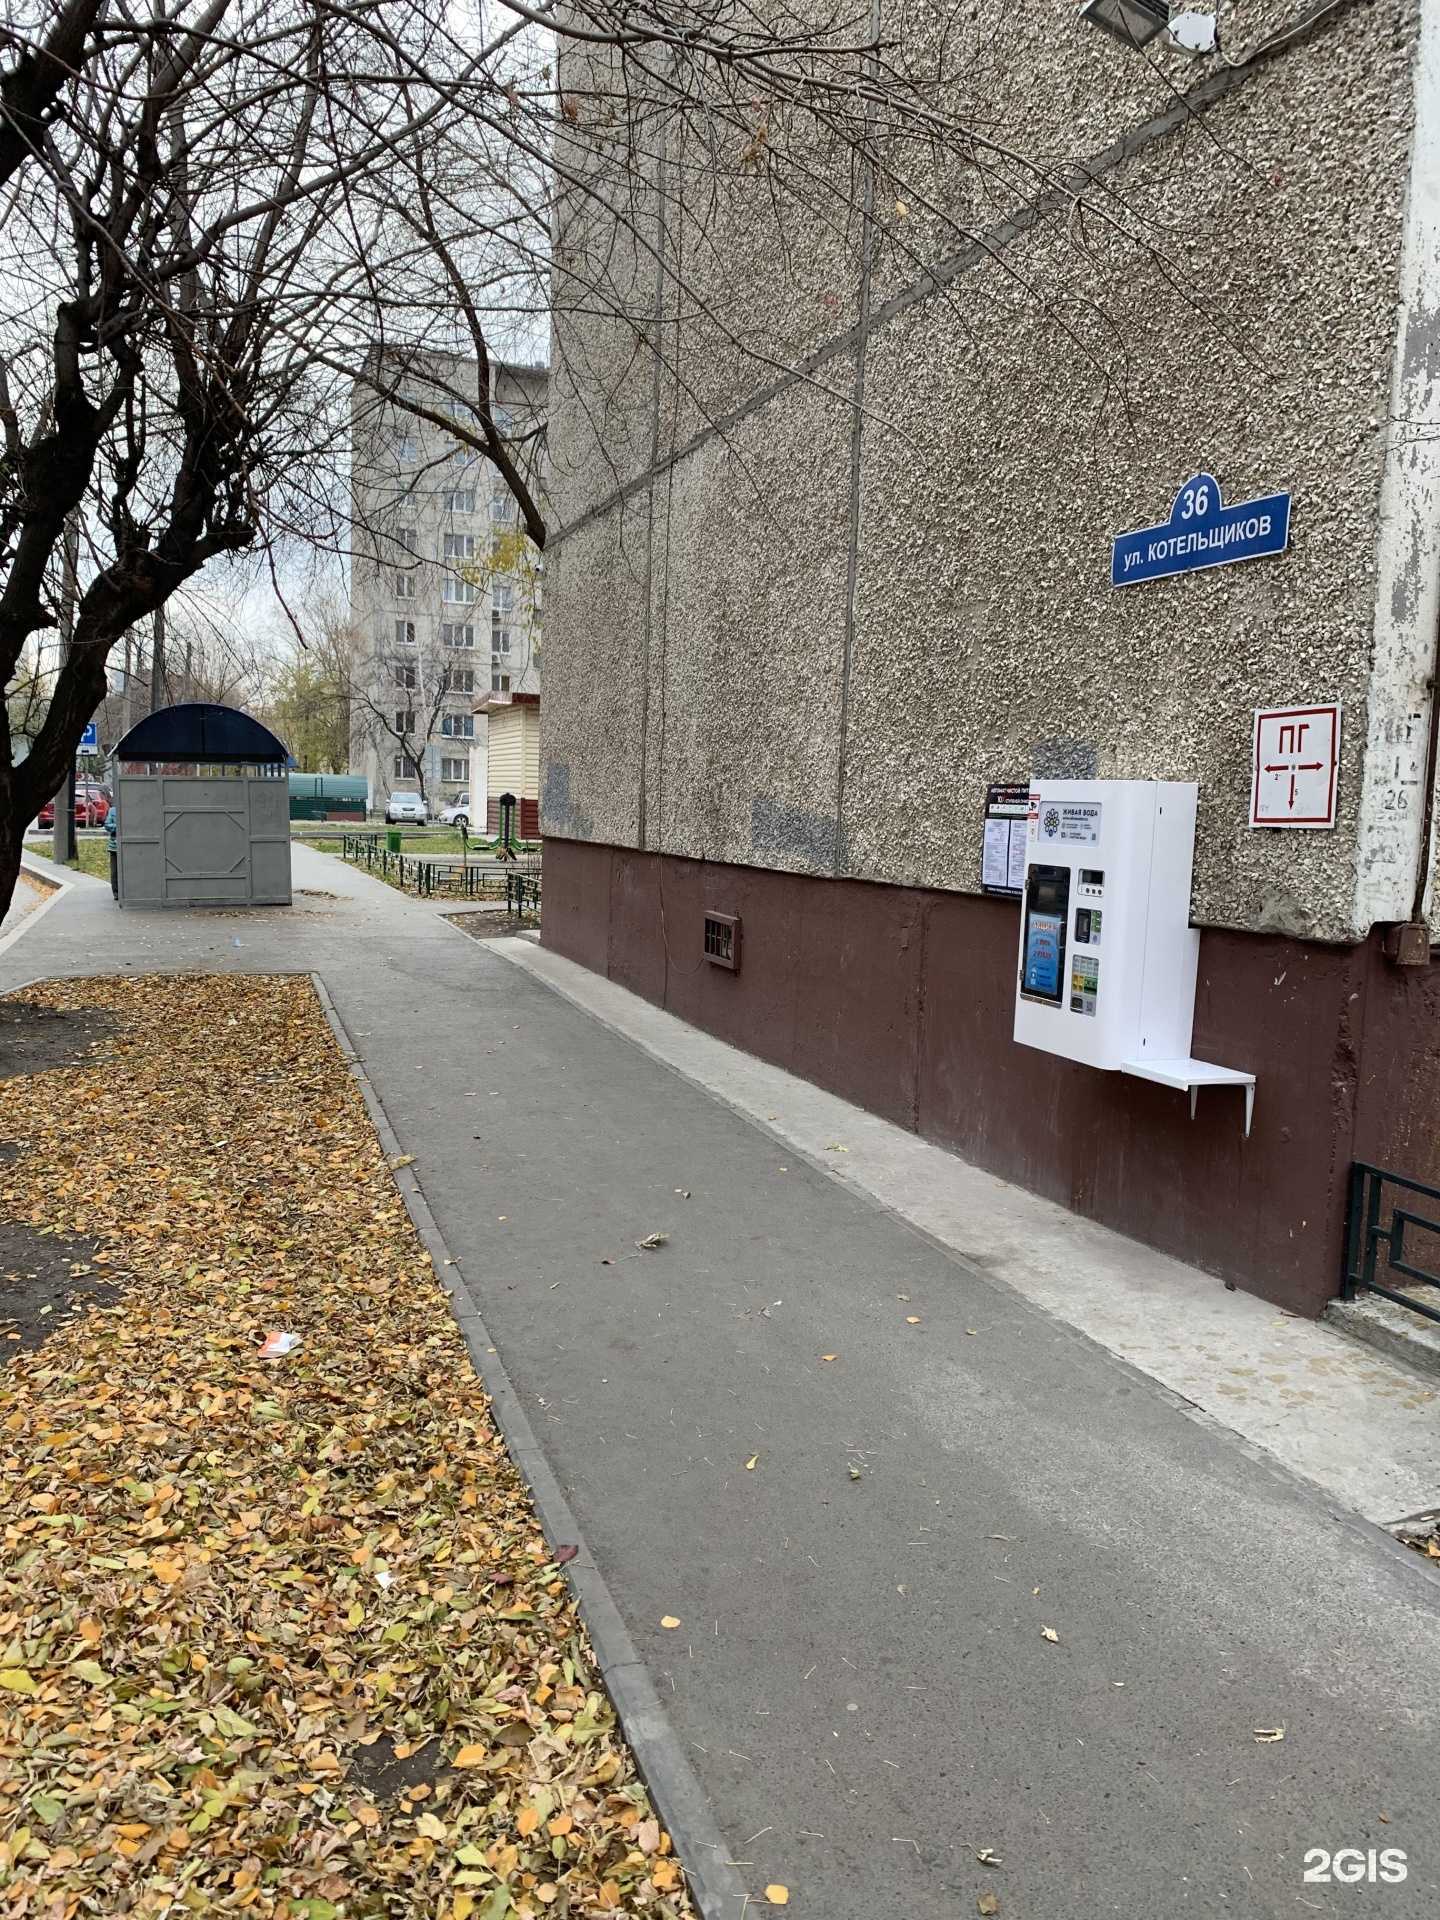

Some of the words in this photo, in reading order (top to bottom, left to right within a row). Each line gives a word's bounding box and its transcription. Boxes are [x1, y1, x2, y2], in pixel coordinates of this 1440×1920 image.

[1181, 485, 1209, 519] 36
[1123, 551, 1144, 572] ул.
[1148, 515, 1271, 562] КОТЕЛЬЩИКОВ
[1279, 723, 1310, 754] ПГ
[1062, 808, 1082, 816] ЖИВАЯ
[1083, 809, 1098, 817] ВОДА
